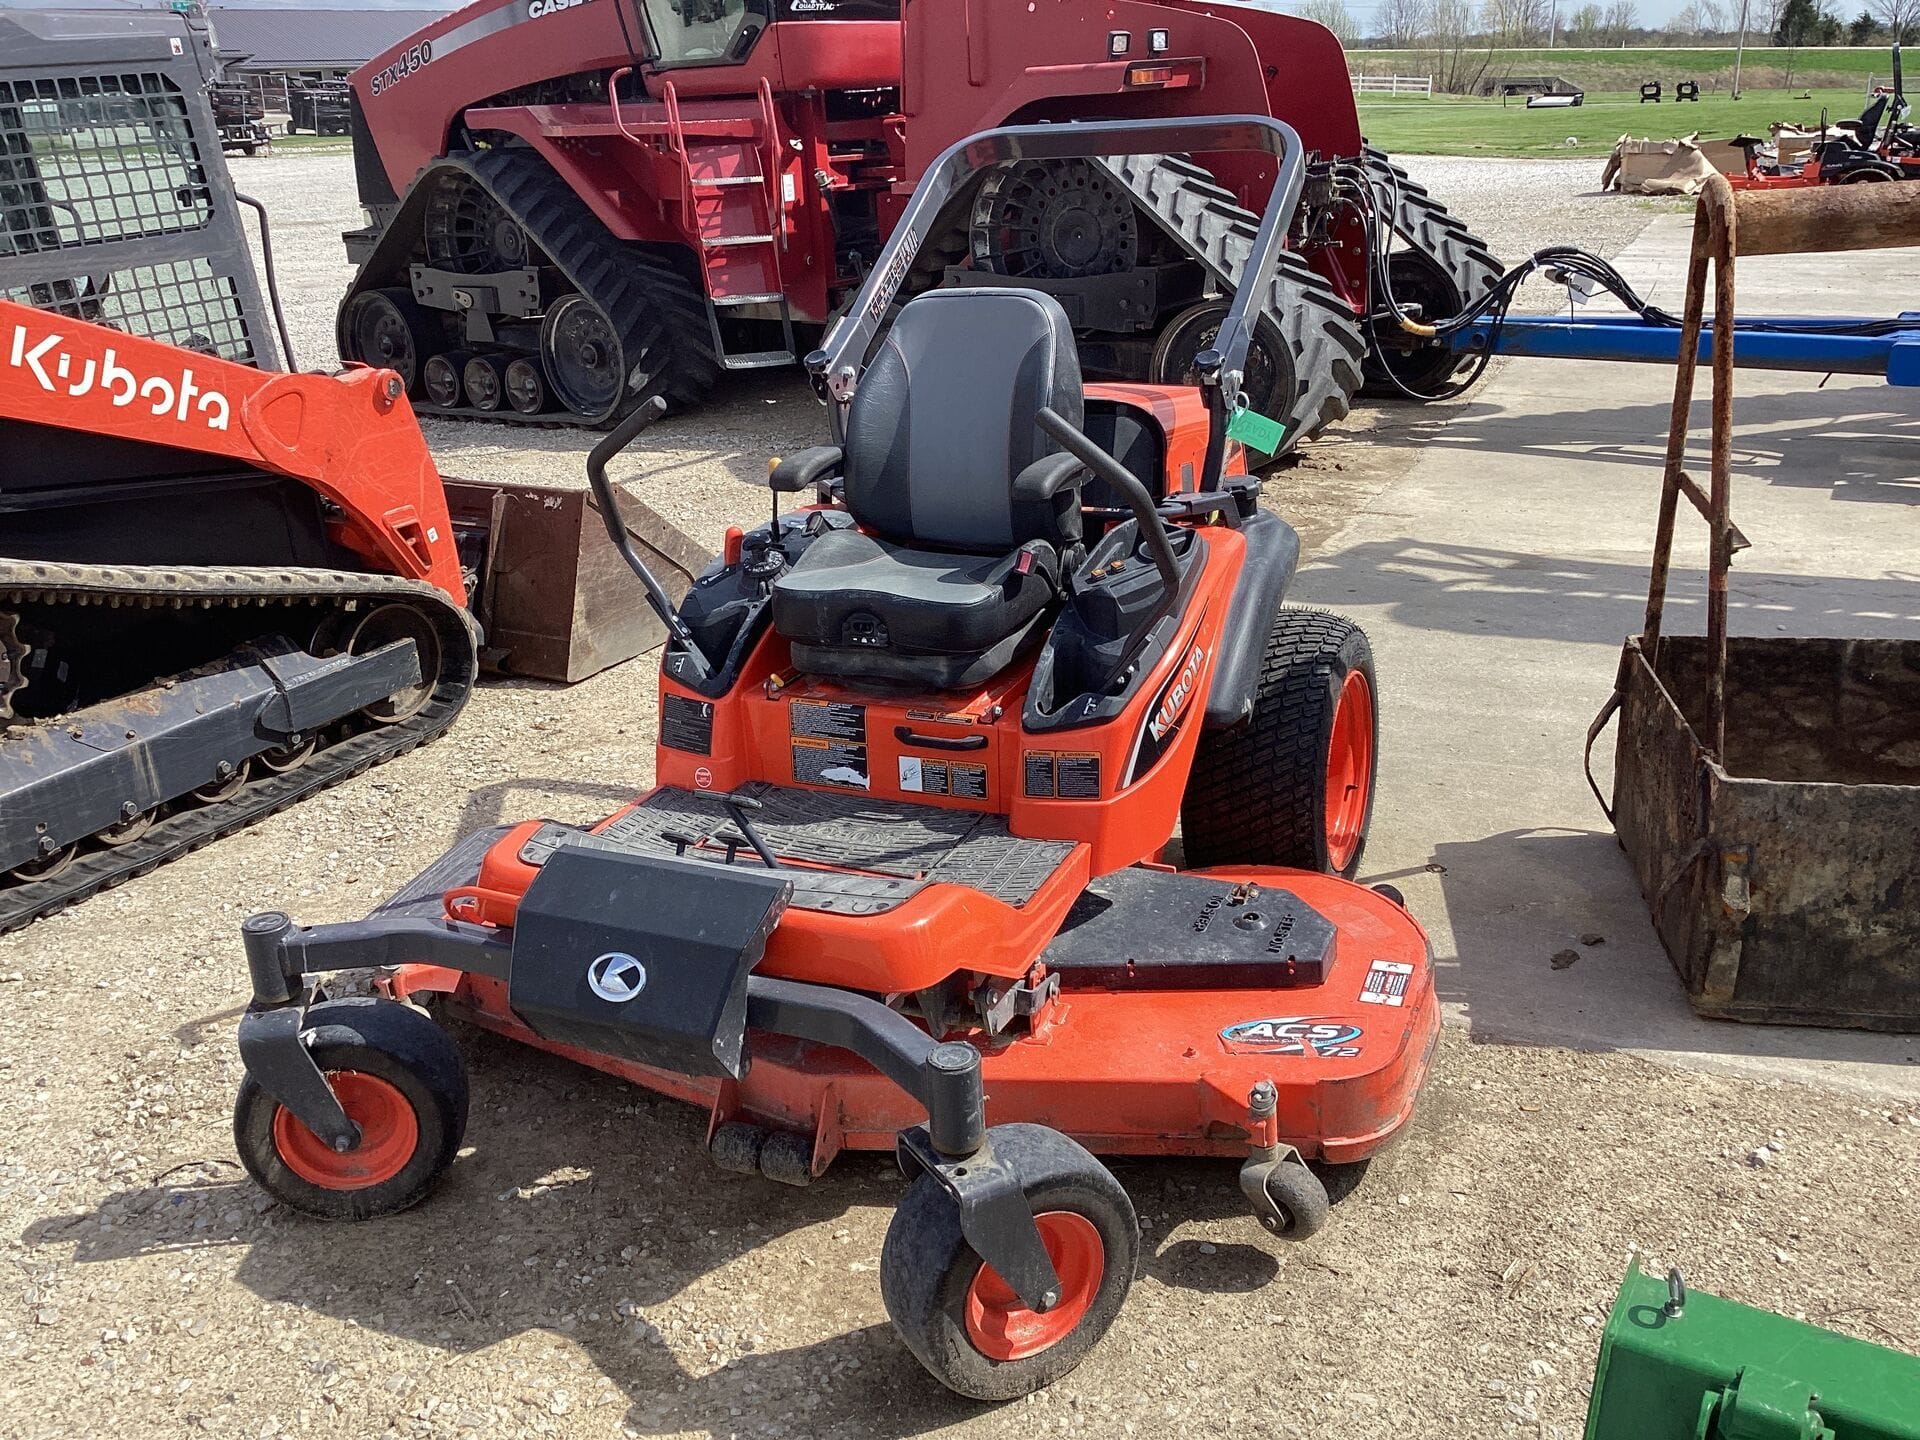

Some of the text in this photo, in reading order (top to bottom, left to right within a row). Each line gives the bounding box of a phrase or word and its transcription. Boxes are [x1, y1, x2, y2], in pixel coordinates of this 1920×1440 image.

[370, 39, 432, 96] STX450
[10, 325, 230, 431] Kubota
[1148, 644, 1205, 743] KUBOTA
[1242, 1022, 1342, 1038] ACS
[1320, 1046, 1360, 1057] 72
